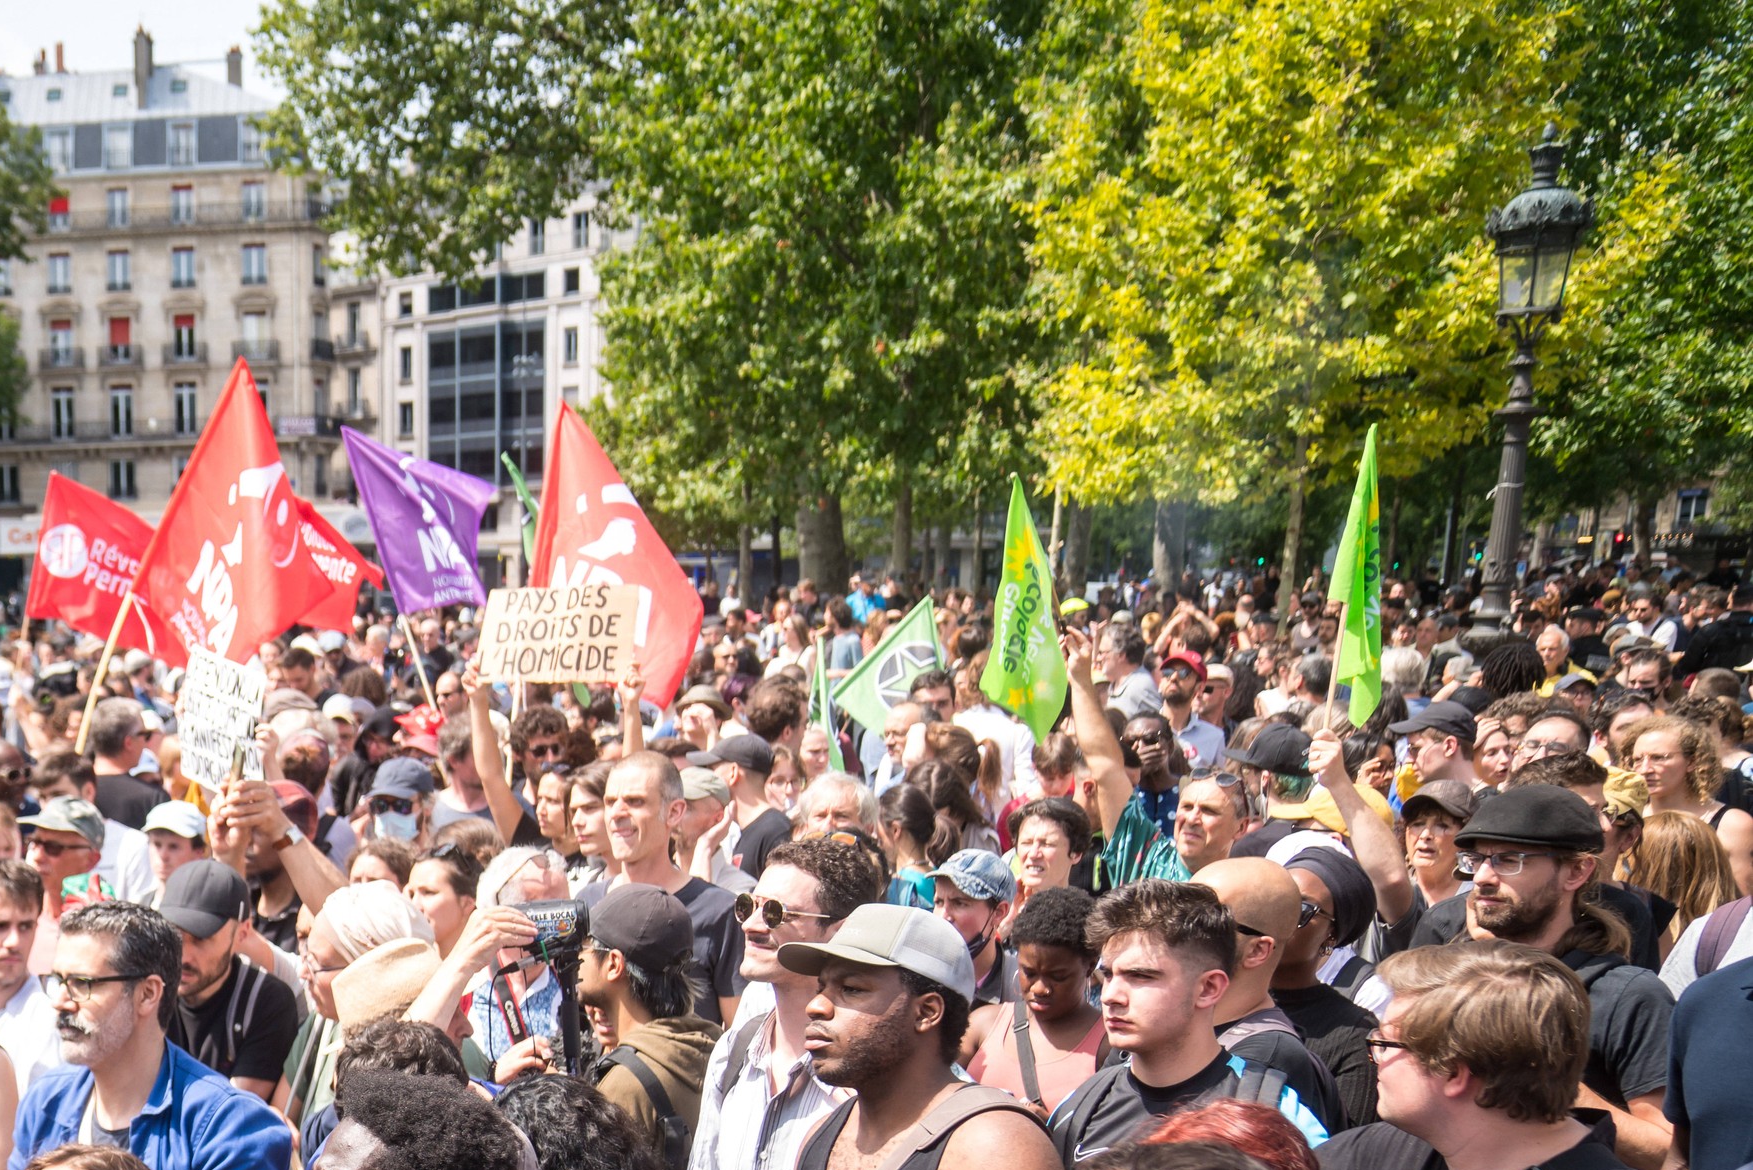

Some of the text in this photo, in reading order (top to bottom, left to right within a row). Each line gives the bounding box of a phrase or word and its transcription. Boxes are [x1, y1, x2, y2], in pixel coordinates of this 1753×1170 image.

[505, 584, 611, 615] PAYS DES
[588, 614, 621, 638] DE
